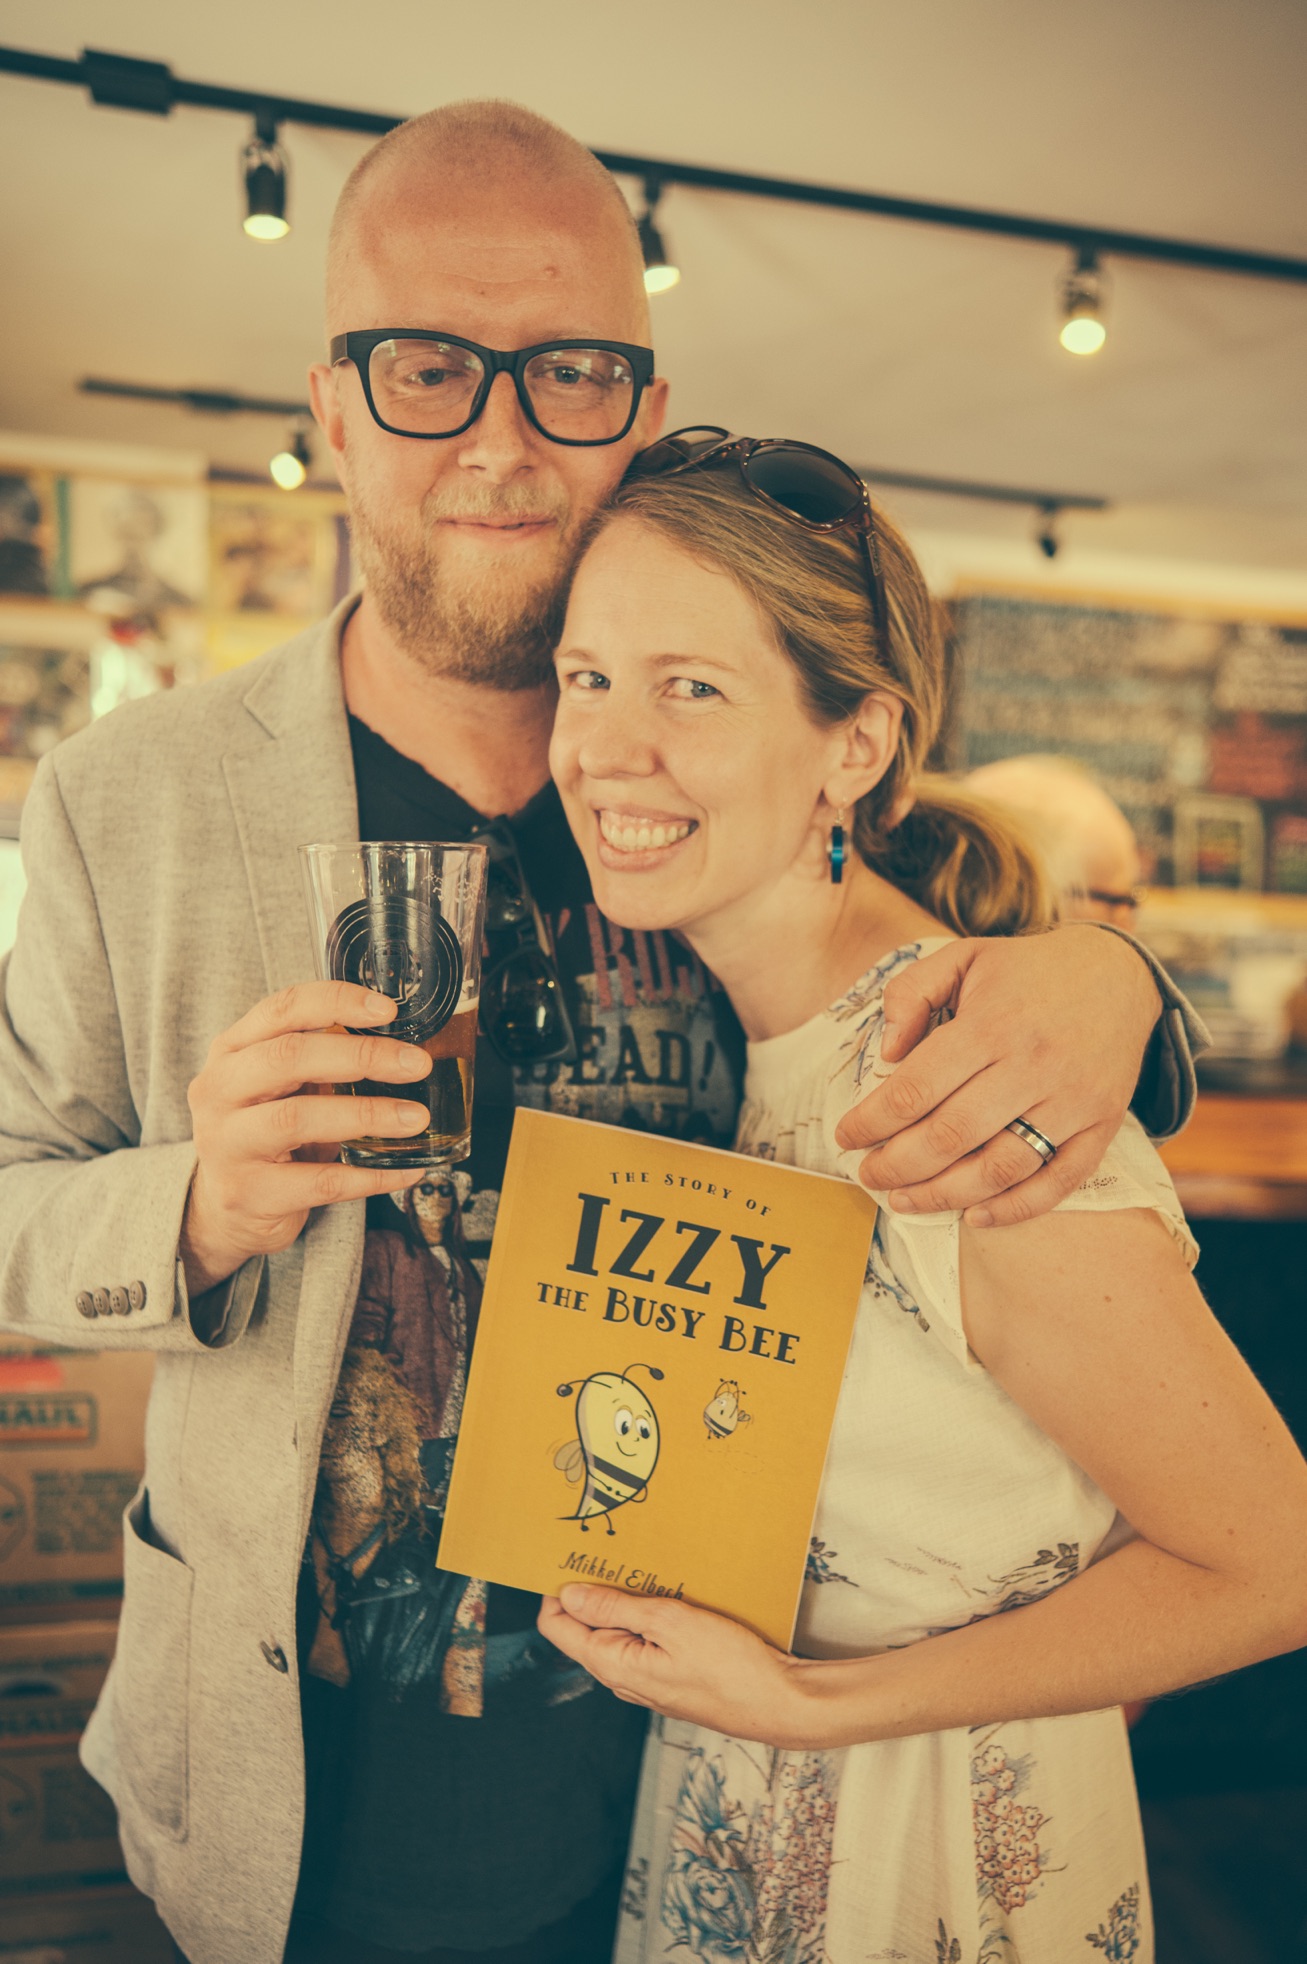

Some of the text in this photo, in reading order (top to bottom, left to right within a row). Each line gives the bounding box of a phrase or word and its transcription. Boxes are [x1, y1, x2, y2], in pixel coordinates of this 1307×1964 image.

[609, 1171, 771, 1217] THE STORY OF
[565, 1192, 792, 1311] IZZY
[536, 1281, 801, 1365] THE BUSY BEE
[558, 1551, 625, 1583] Mikkel
